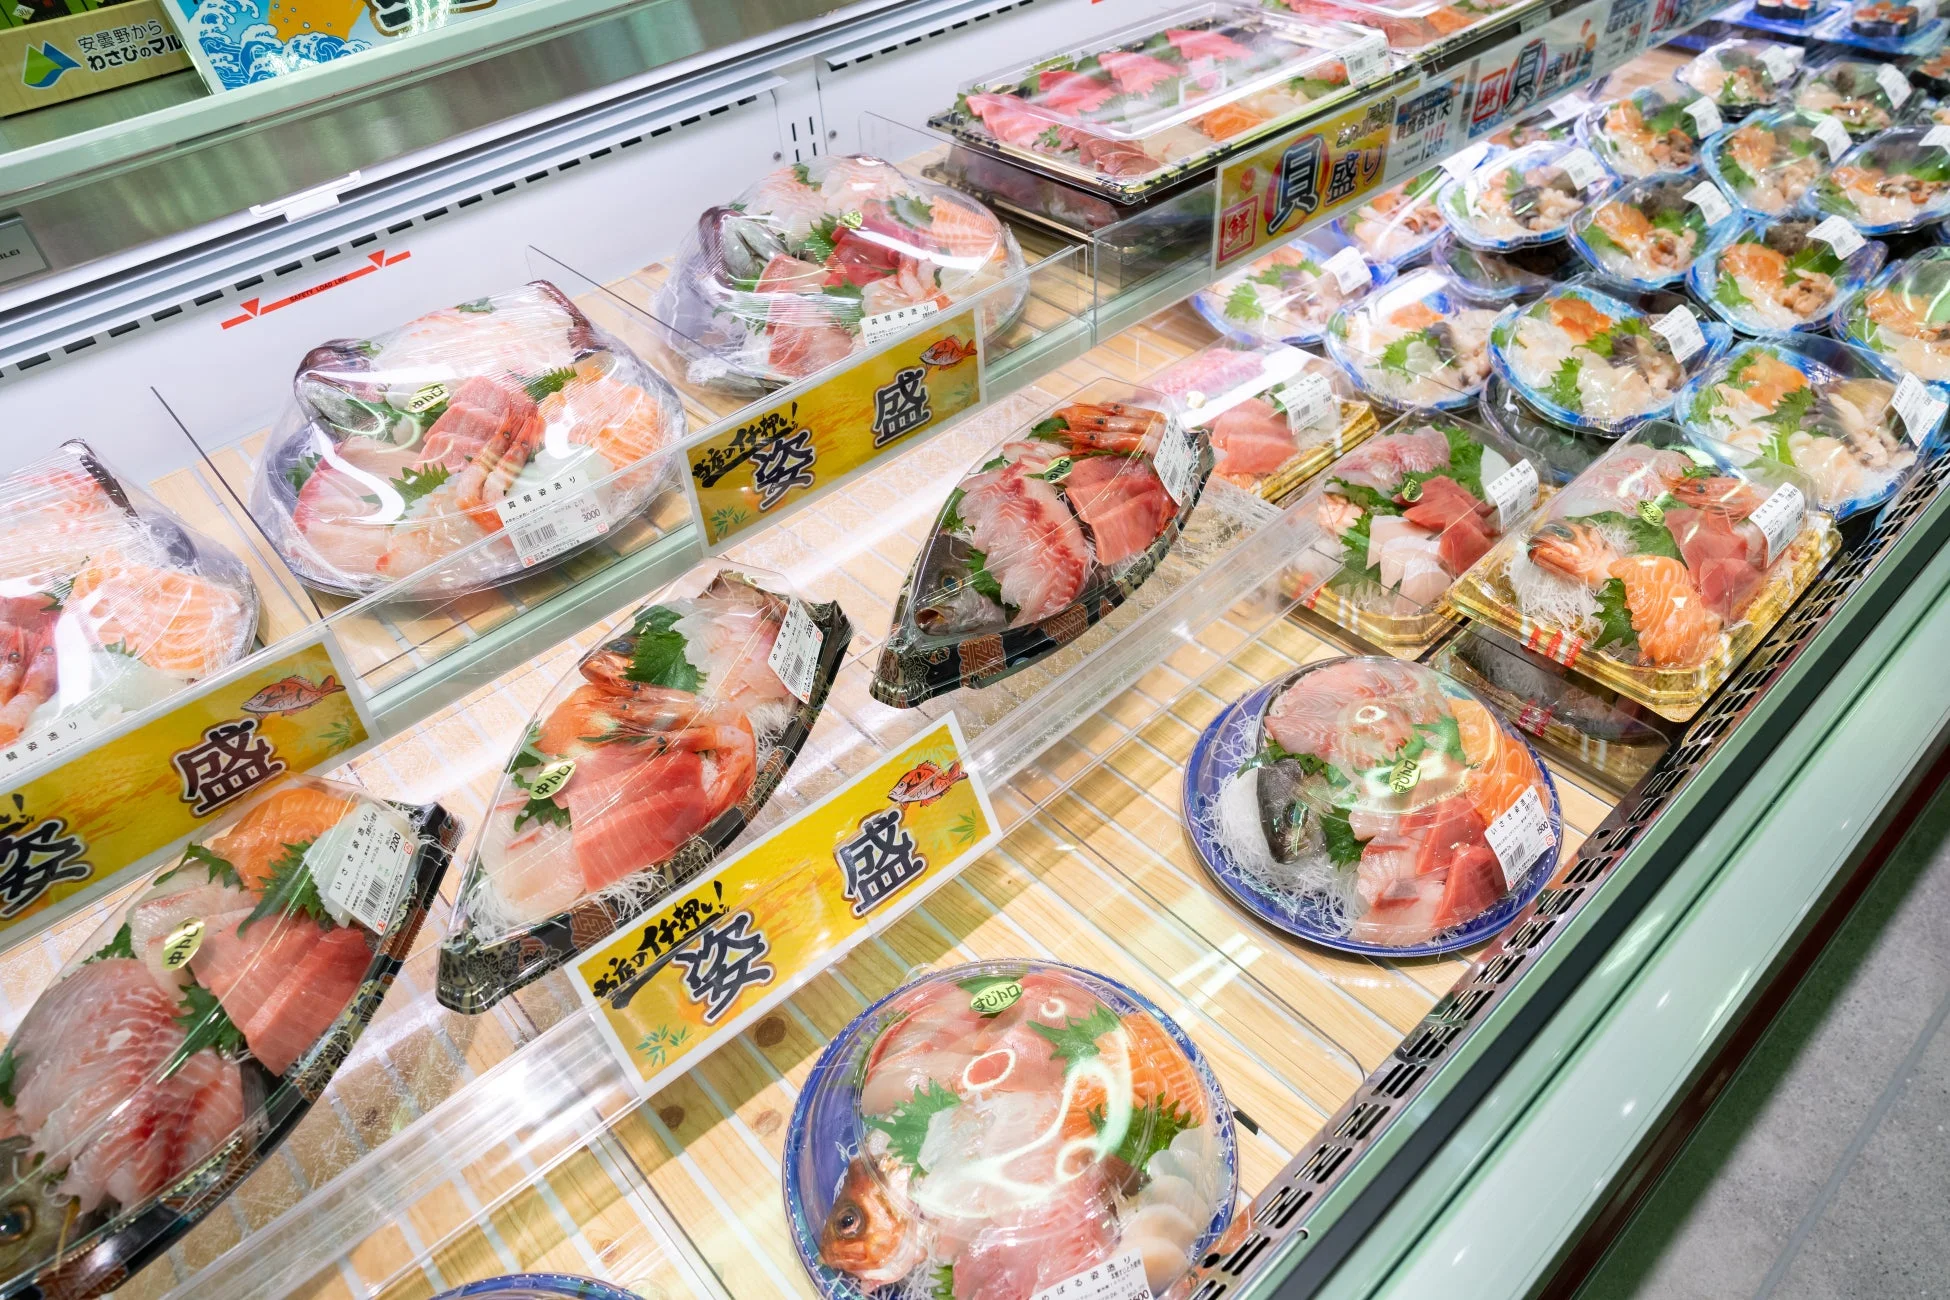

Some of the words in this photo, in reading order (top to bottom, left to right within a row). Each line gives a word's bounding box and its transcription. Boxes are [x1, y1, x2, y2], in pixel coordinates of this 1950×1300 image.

[78, 21, 162, 53] 安曇野から
[289, 288, 314, 303] SAFETY
[316, 280, 333, 293] LOAD
[752, 430, 815, 511] 姿
[873, 367, 932, 448] 盛
[581, 508, 601, 523] 3000
[176, 717, 288, 818] 盛
[389, 832, 401, 853] 2200
[671, 911, 776, 1026] 姿
[836, 809, 927, 918] 盛
[973, 984, 1021, 1012] すじトロ
